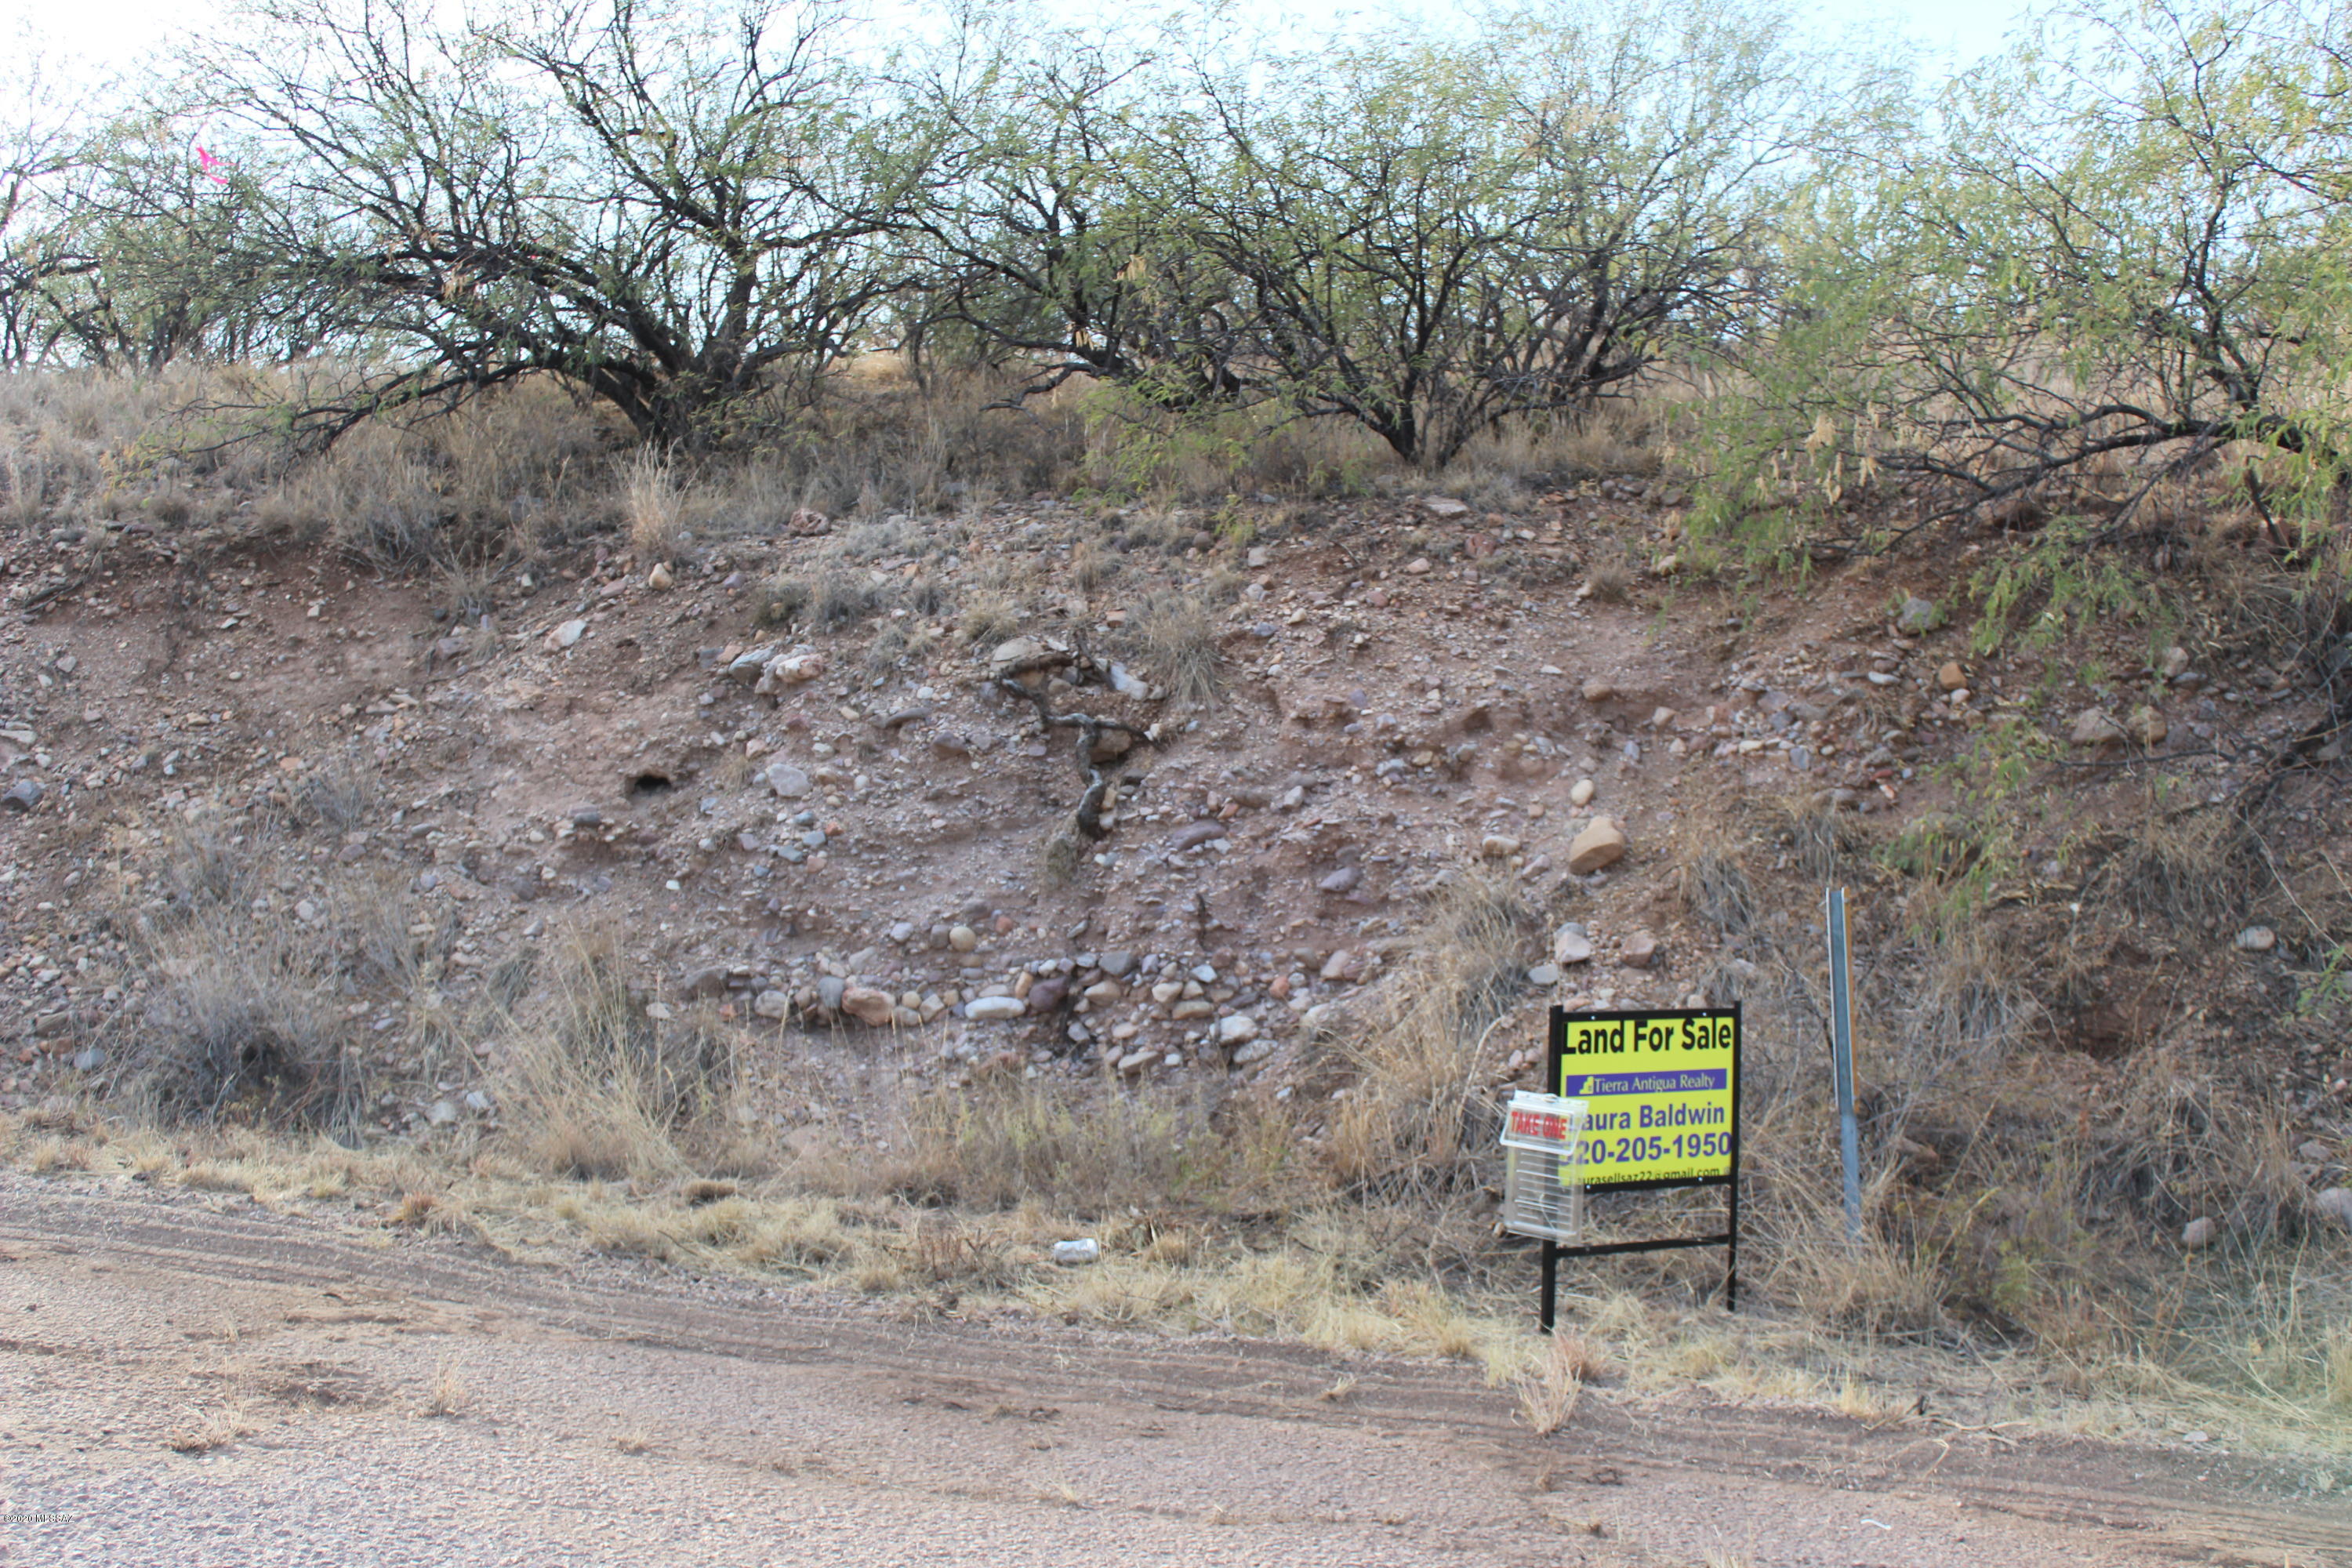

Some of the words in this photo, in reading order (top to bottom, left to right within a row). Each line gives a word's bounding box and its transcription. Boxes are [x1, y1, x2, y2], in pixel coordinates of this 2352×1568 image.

[1563, 1020, 1624, 1054] Land
[1634, 1020, 1674, 1052] For
[1681, 1018, 1732, 1051] Sale
[1594, 1077, 1628, 1093] Tierra
[1632, 1076, 1676, 1094] Antigua
[1680, 1073, 1715, 1090] Realty
[1511, 1111, 1541, 1136] TAKE
[1542, 1115, 1568, 1140] ONE
[1639, 1102, 1725, 1129] Baldwin
